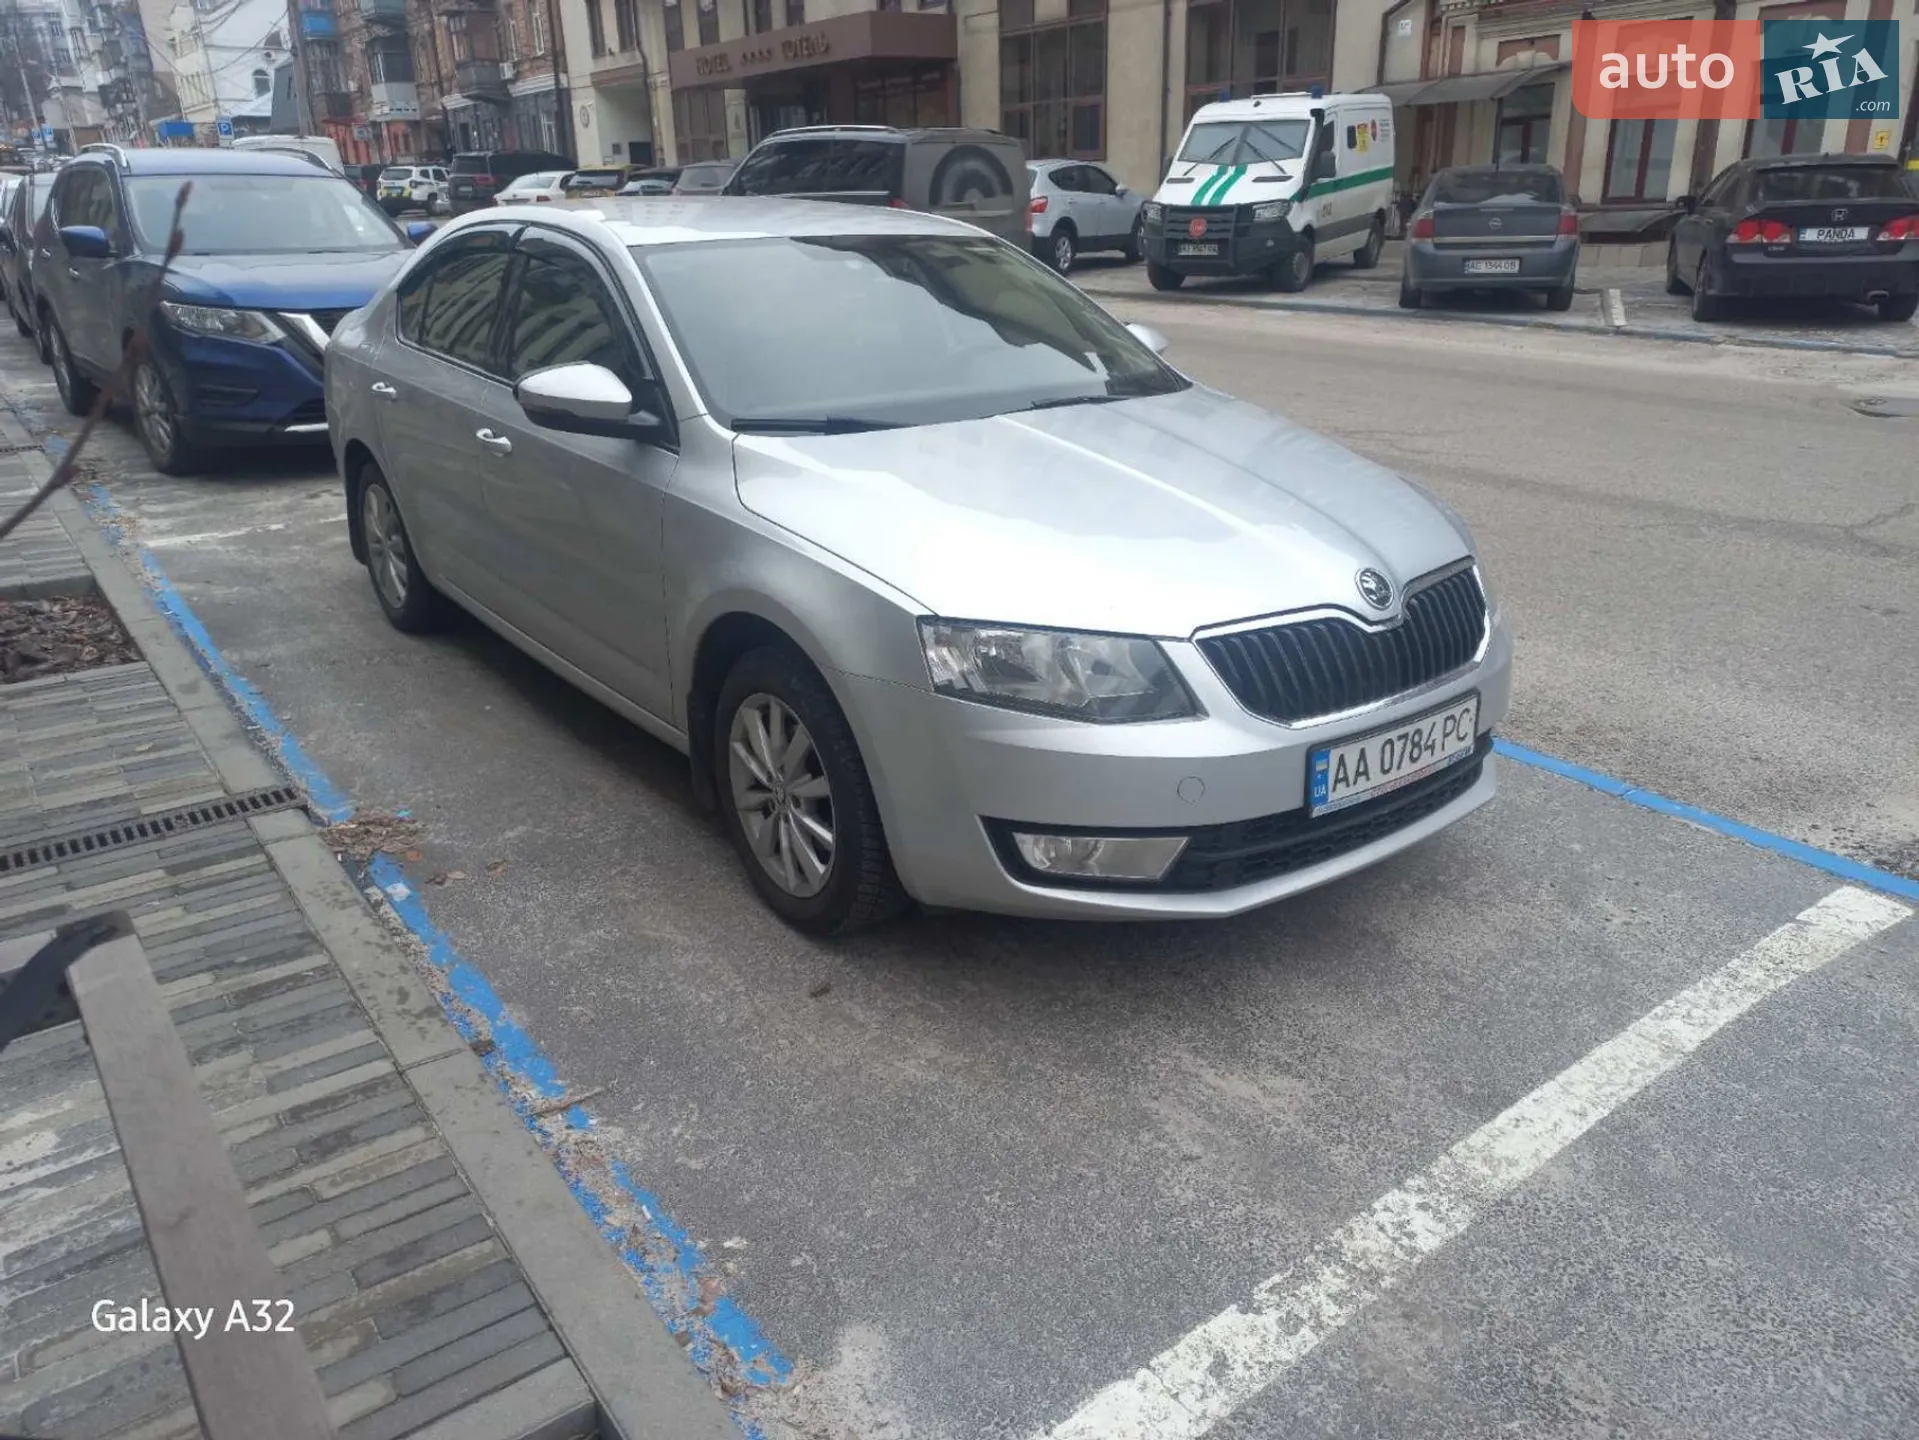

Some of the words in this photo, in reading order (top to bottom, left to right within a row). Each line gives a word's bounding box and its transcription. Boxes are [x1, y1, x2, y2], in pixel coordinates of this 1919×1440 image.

[1816, 227, 1856, 240] PANDA
[1331, 747, 1371, 793] AA
[1379, 721, 1438, 776] 0784
[1441, 707, 1471, 752] PC
[1313, 787, 1327, 798] UA
